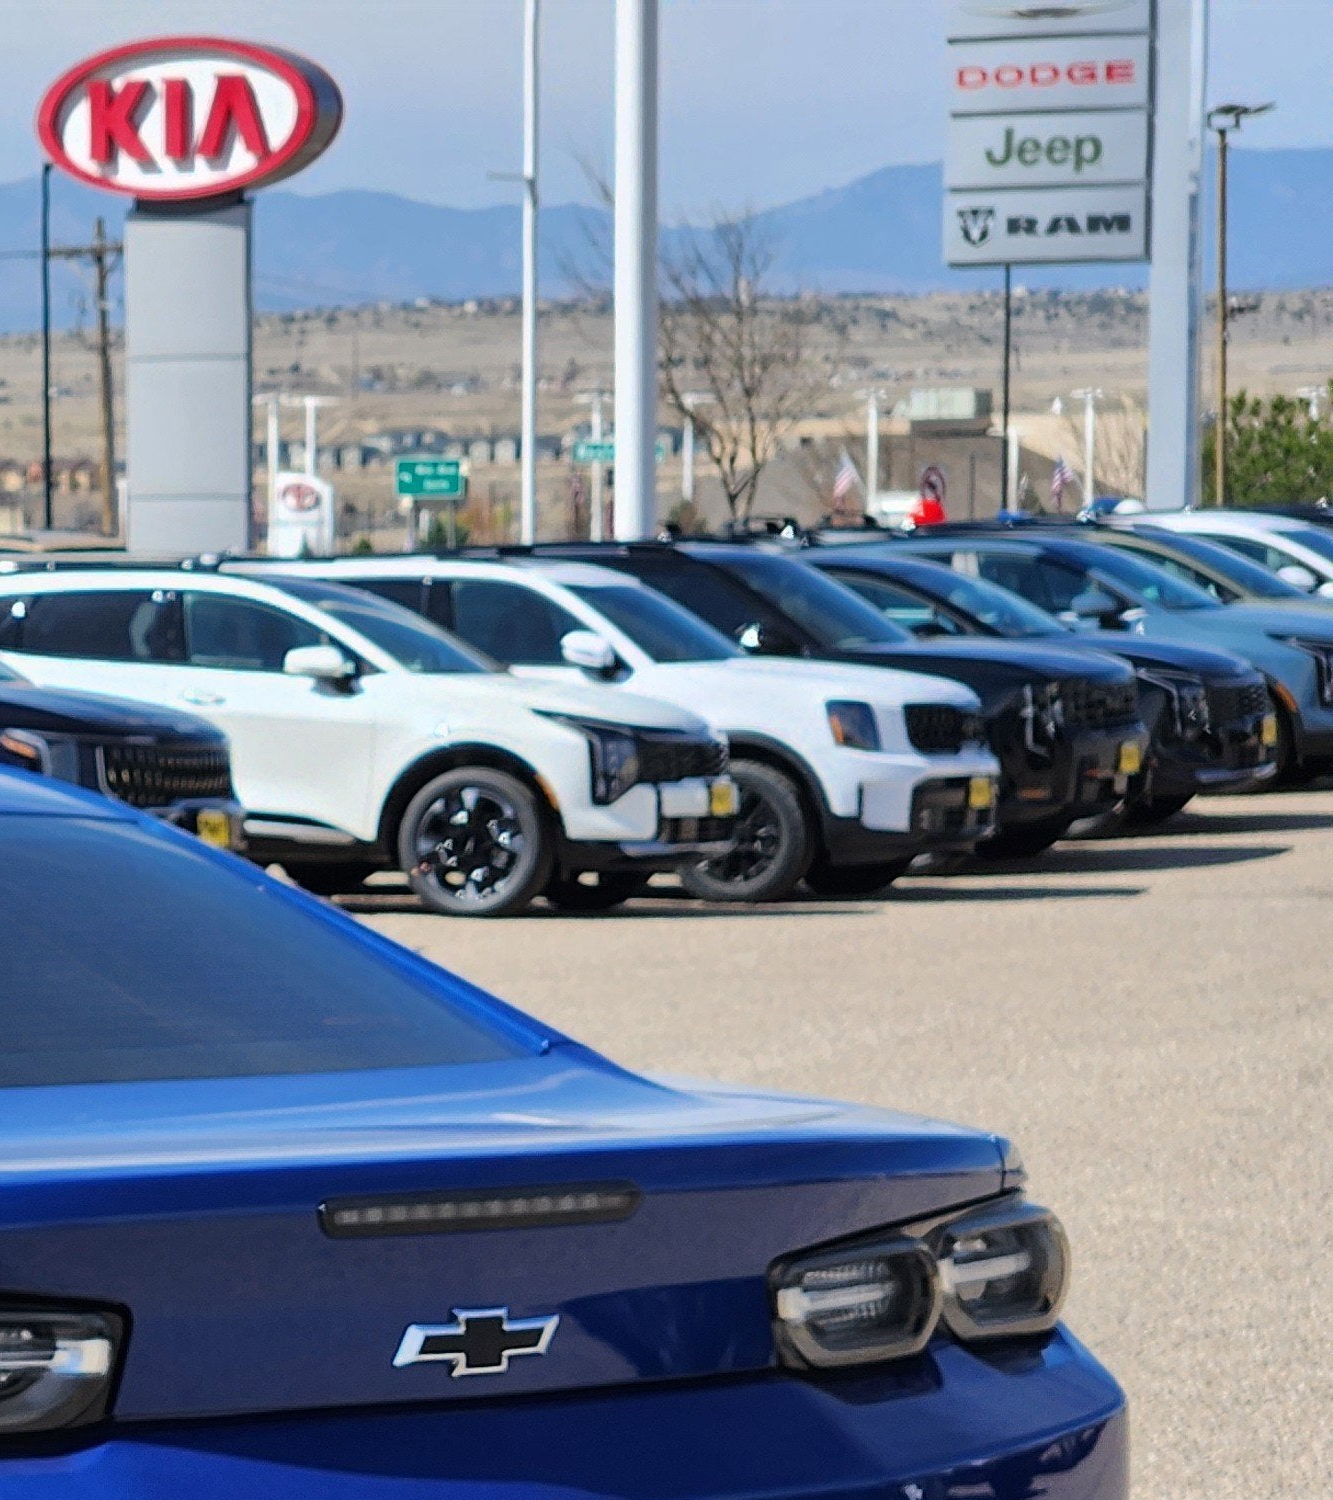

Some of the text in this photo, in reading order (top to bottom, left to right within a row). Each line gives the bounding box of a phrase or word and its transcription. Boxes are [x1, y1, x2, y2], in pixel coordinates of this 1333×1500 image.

[956, 58, 1136, 91] DODGE
[86, 73, 272, 164] KIA
[985, 127, 1103, 174] Jeep
[1005, 213, 1132, 236] RAM
